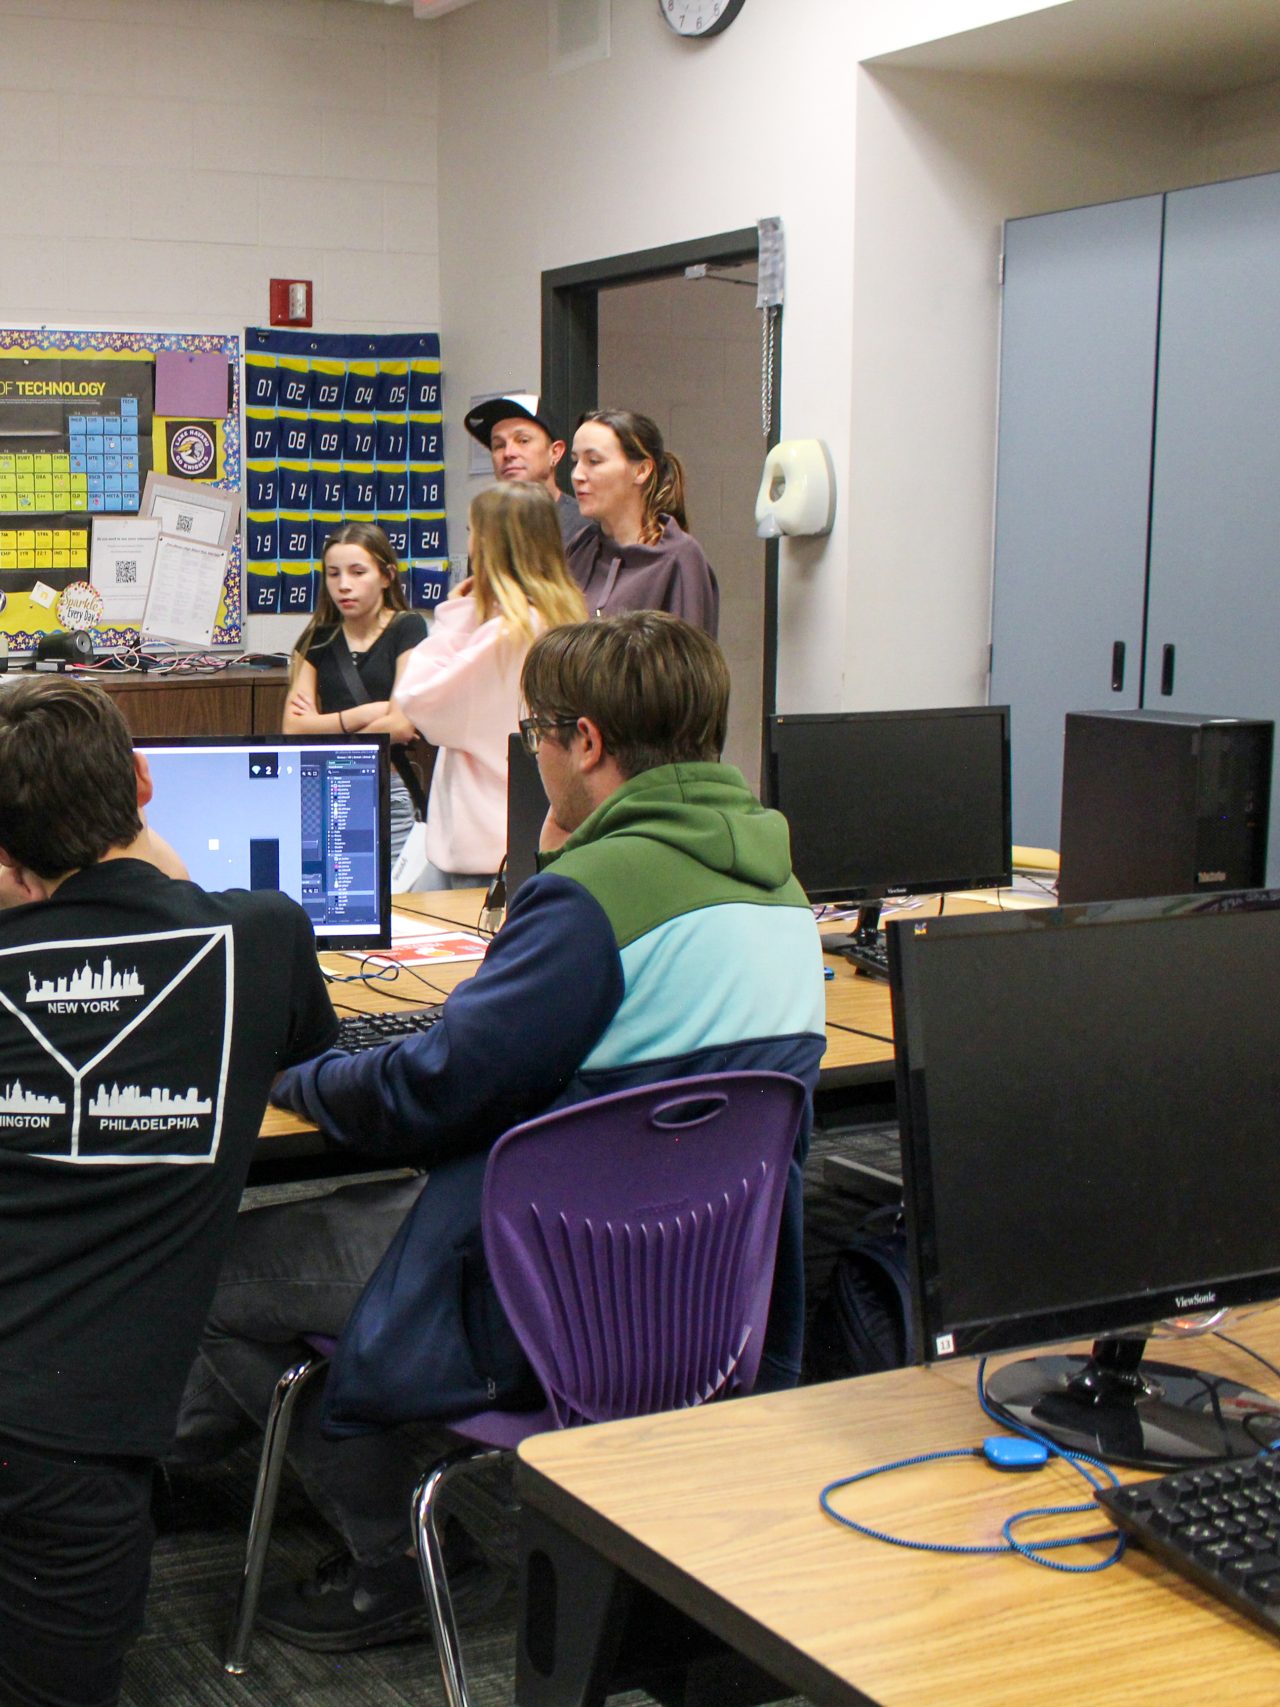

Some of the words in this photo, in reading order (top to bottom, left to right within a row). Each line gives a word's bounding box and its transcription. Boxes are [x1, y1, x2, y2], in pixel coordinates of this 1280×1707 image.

[15, 381, 106, 397] TECHNOLOGY
[256, 379, 272, 397] 01
[287, 383, 306, 401] 02
[319, 386, 339, 402] 03
[355, 387, 374, 403] 04
[389, 387, 406, 403] 05
[420, 385, 437, 402] 06
[175, 430, 189, 446] LAKE
[190, 430, 210, 447] HAVASU
[254, 431, 271, 449] 07
[288, 431, 306, 450] 08
[320, 434, 338, 451] 09
[355, 435, 371, 452] 10
[389, 436, 403, 453] 11
[421, 436, 437, 453] 12
[258, 483, 273, 501] 13
[290, 483, 308, 501] 14
[325, 484, 341, 502] 15
[357, 485, 373, 502] 16
[389, 485, 405, 502] 17
[422, 485, 438, 502] 18
[256, 535, 272, 553] 19
[289, 534, 307, 552] 20
[389, 533, 407, 550] 23
[421, 532, 440, 549] 24
[258, 588, 276, 605] 25
[289, 587, 307, 604] 26
[422, 582, 442, 600] 30
[64, 592, 99, 612] Sparkle
[67, 606, 83, 620] Every
[84, 609, 97, 623] Day
[265, 766, 272, 775] 2
[277, 766, 282, 775] /
[286, 766, 293, 775] 9
[48, 1002, 78, 1014] NEW
[81, 1000, 120, 1013] YORK
[99, 1117, 200, 1131] PHILADELPHIA
[1175, 1290, 1217, 1309] ViewSonic
